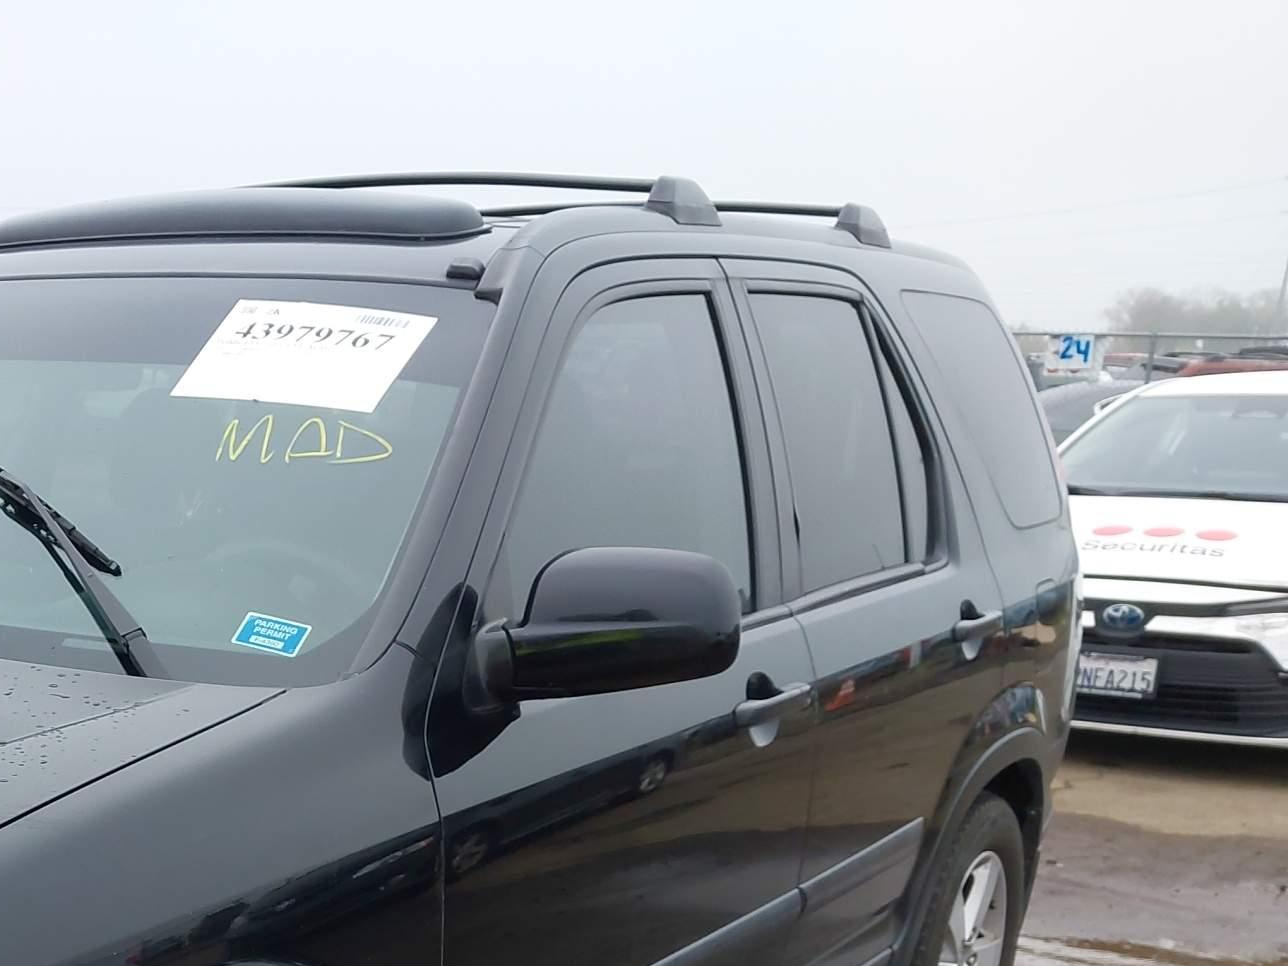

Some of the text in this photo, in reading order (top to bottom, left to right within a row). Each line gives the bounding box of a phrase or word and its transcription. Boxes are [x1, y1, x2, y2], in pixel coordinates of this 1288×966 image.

[234, 321, 396, 351] 43979767
[1060, 336, 1090, 363] 24
[215, 414, 393, 464] MAD
[1080, 539, 1225, 558] Securitas
[253, 626, 291, 640] PERMIT
[254, 618, 298, 635] PARKING
